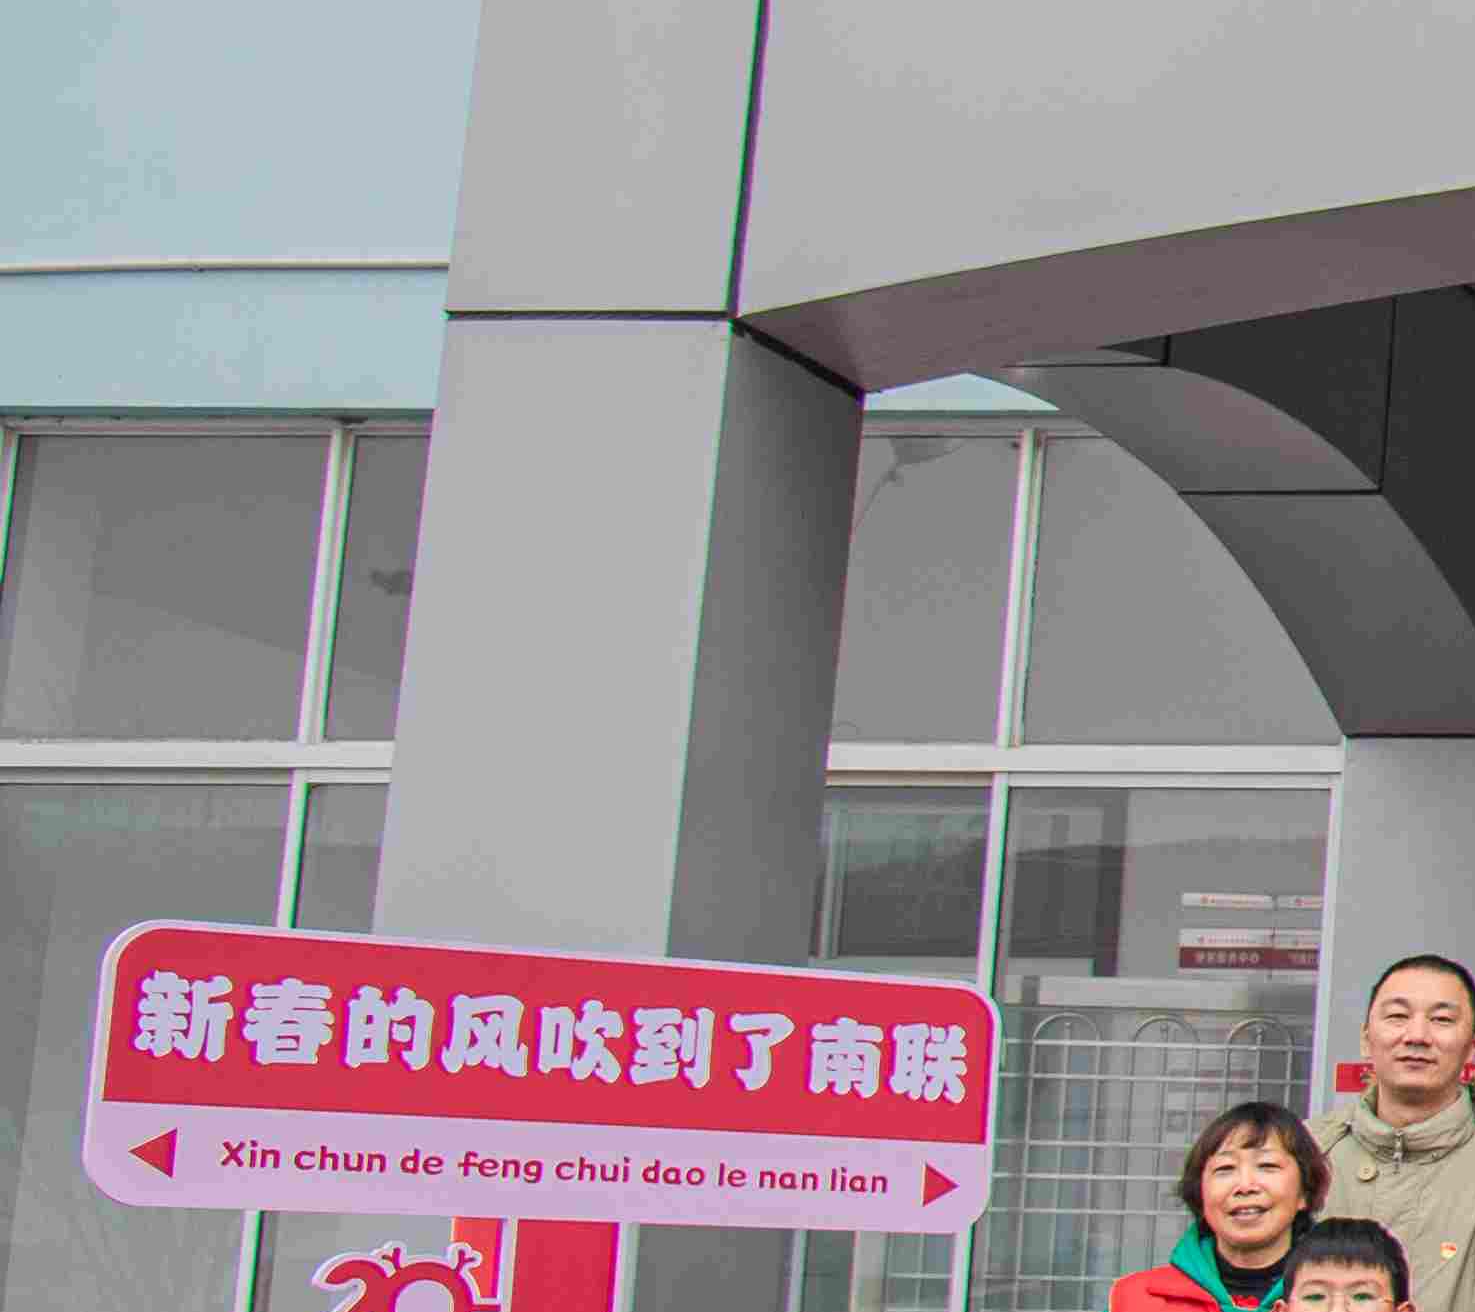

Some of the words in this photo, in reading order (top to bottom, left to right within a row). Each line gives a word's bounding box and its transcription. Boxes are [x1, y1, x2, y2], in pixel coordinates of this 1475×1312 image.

[133, 969, 968, 1103] 新春的风吹到了南联
[220, 1140, 281, 1169] Xin
[294, 1144, 388, 1174] chun
[399, 1148, 444, 1175] de
[457, 1151, 543, 1184] feng
[554, 1156, 631, 1184] chui
[641, 1159, 706, 1186] dao
[717, 1162, 747, 1188] le
[758, 1168, 819, 1192] nan
[829, 1166, 889, 1194] lian
